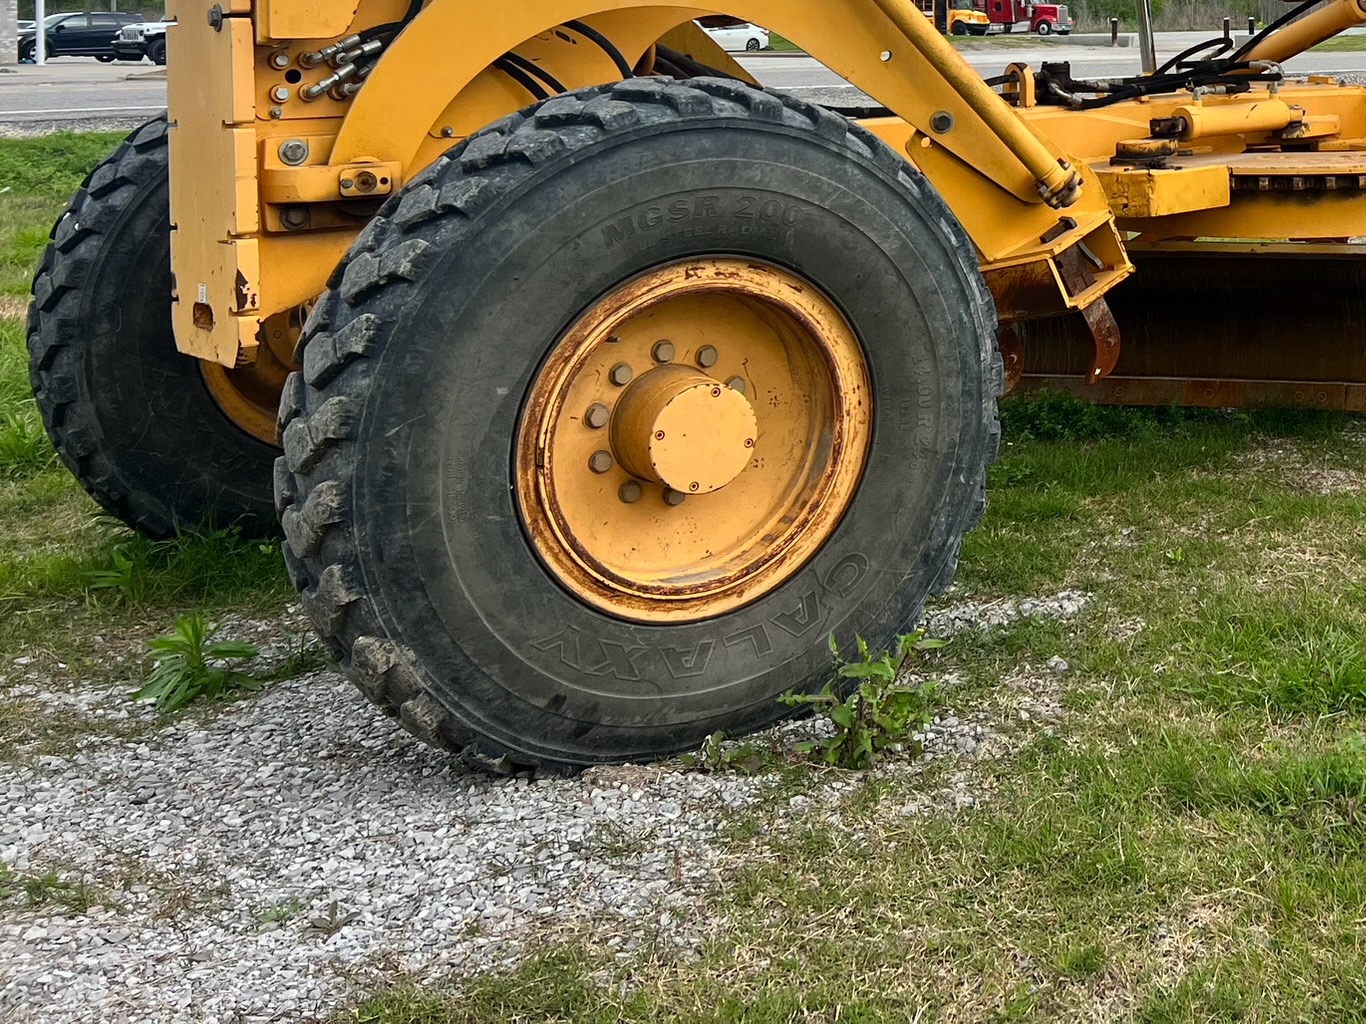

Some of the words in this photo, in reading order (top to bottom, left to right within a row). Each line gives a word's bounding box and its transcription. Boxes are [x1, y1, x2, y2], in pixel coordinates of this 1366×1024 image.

[601, 194, 721, 249] MGSR
[733, 195, 803, 227] 200
[718, 224, 777, 241] RADIAL
[527, 552, 870, 682] GALAXY
